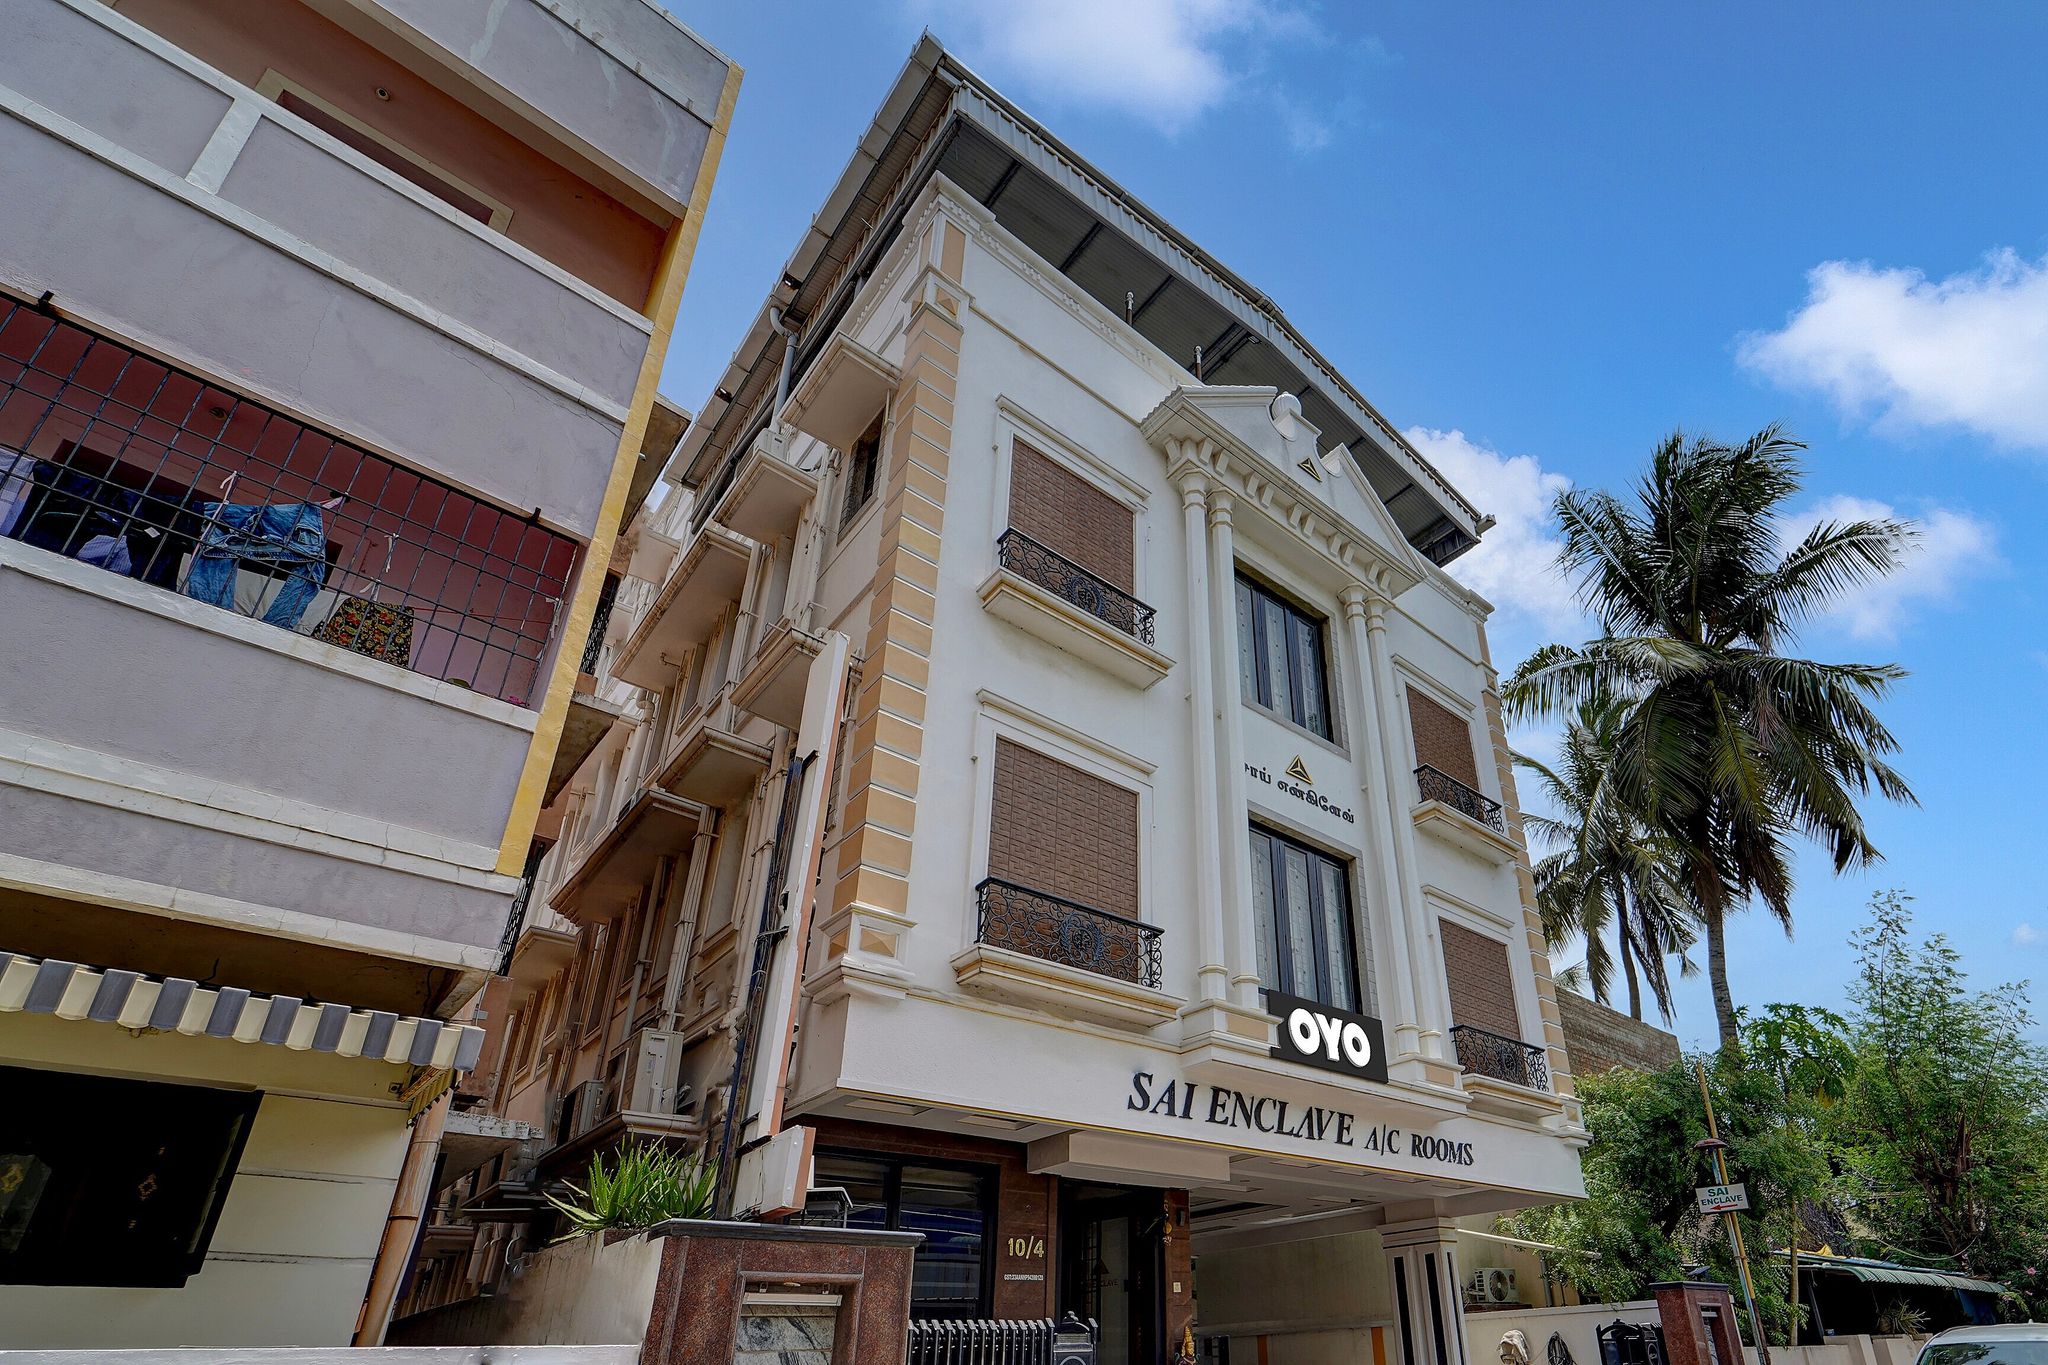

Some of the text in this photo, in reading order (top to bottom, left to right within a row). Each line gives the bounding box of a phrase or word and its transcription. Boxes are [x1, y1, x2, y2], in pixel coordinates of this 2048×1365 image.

[1288, 1008, 1370, 1068] OYO
[1127, 1072, 1198, 1119] SAI
[1205, 1085, 1354, 1147] ENCLAVE
[1411, 1133, 1474, 1166] ROOMS
[1701, 1194, 1743, 1206] ENCLAVE
[1708, 1187, 1729, 1197] SAI
[1008, 1235, 1044, 1259] 10/4
